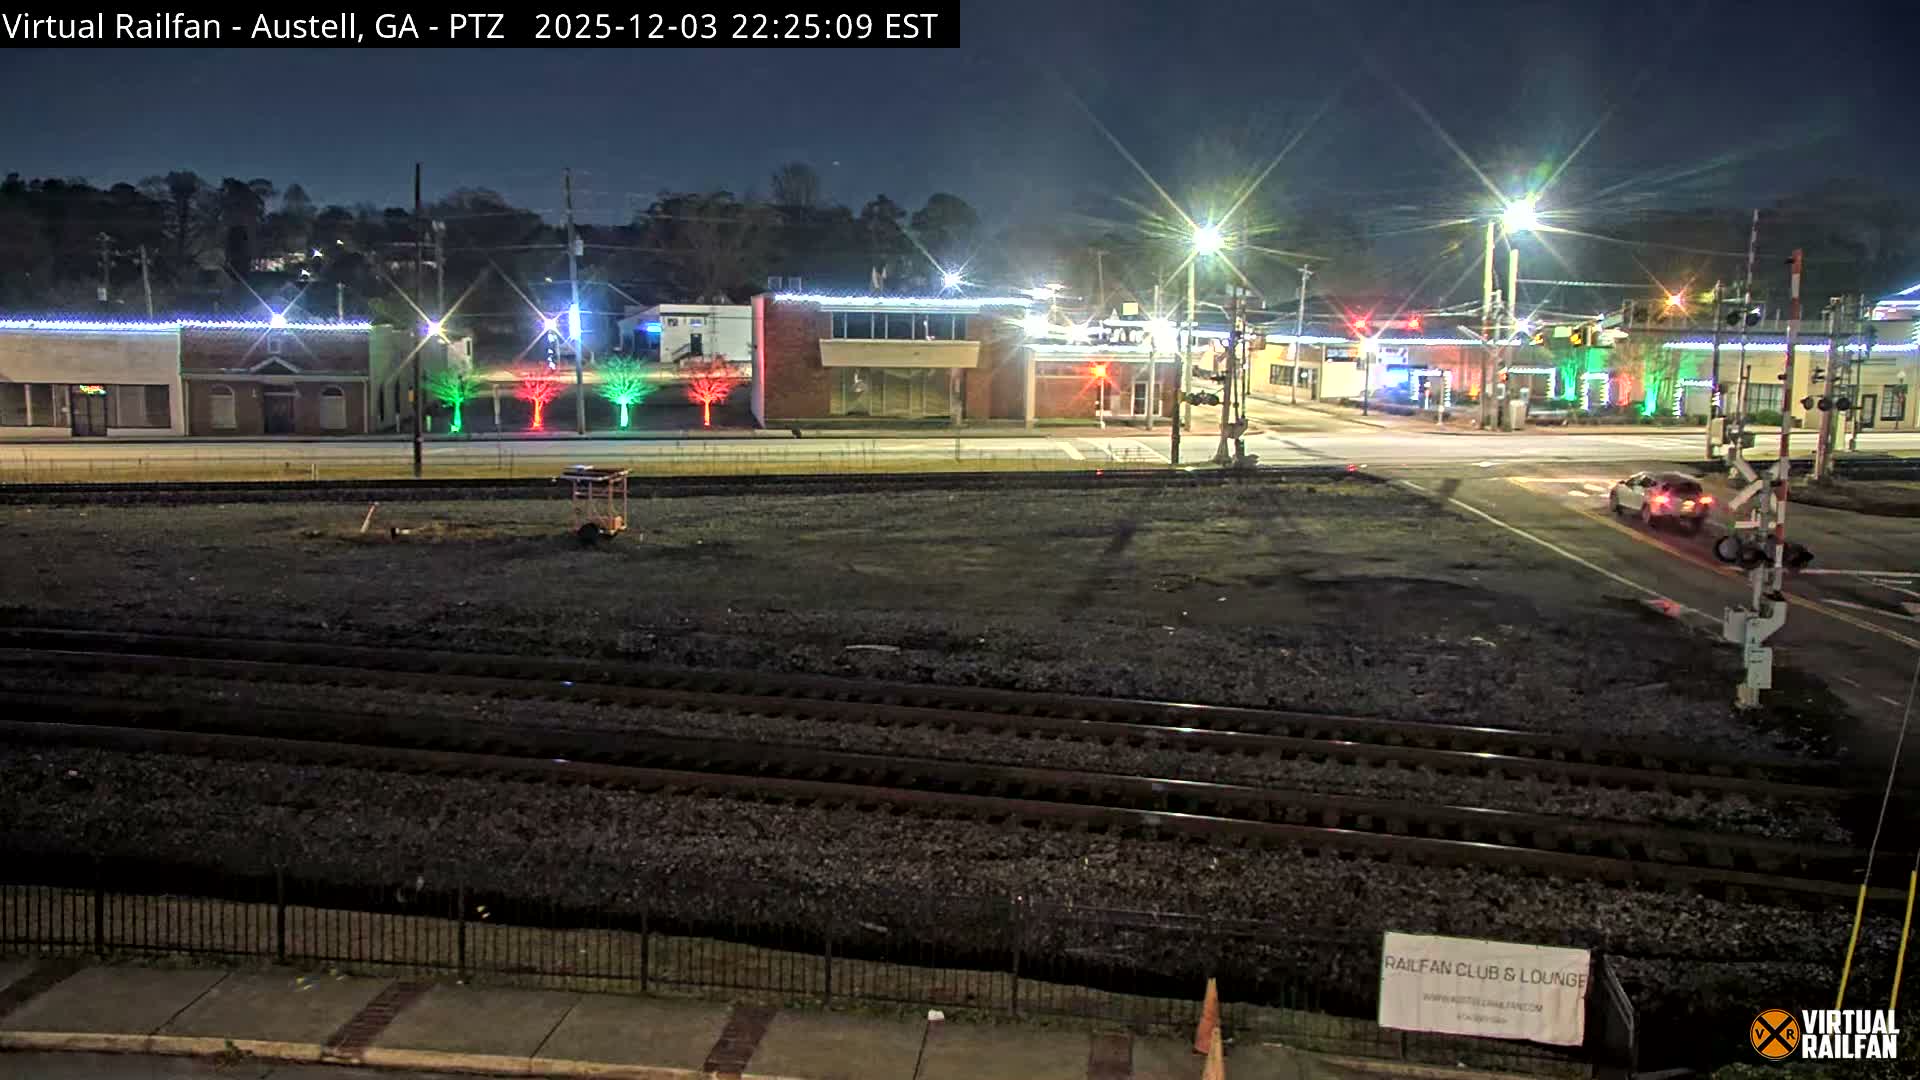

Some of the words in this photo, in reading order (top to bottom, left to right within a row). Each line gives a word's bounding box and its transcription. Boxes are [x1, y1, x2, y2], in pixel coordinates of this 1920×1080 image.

[1384, 955, 1451, 975] RAILFAN
[1455, 961, 1499, 981] CLUB
[1503, 967, 1517, 982] &
[1520, 969, 1588, 989] LOUNGE
